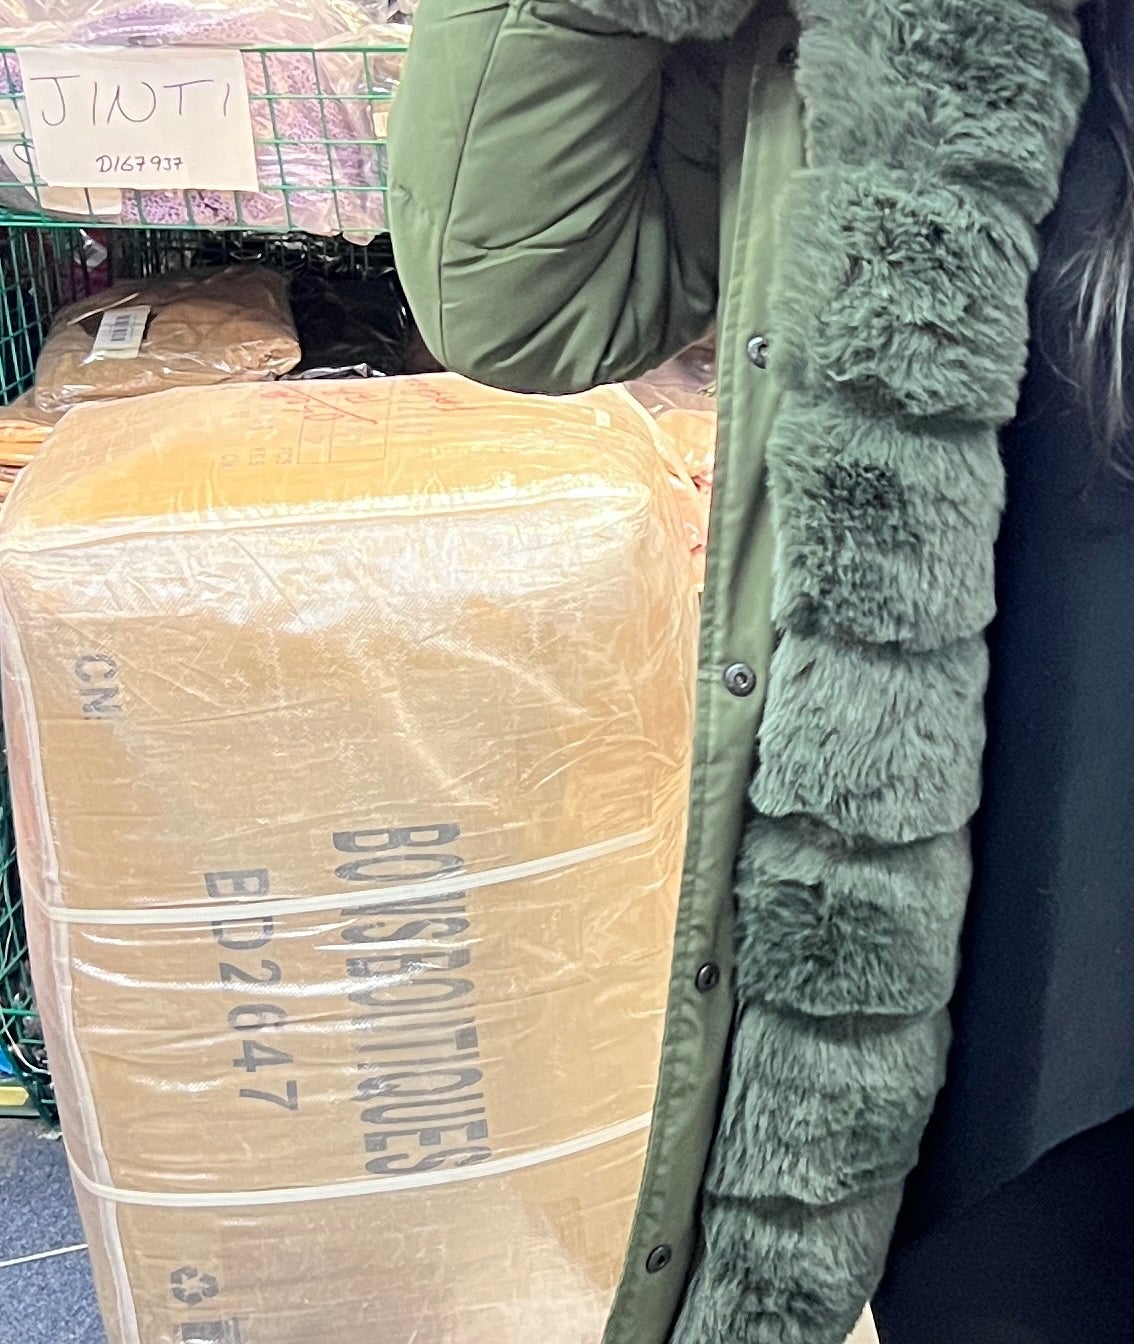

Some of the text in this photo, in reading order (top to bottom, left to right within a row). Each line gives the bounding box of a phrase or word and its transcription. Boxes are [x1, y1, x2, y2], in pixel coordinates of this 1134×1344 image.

[30, 74, 230, 126] JINTI
[75, 654, 122, 720] CN
[204, 868, 298, 1111] BD2647
